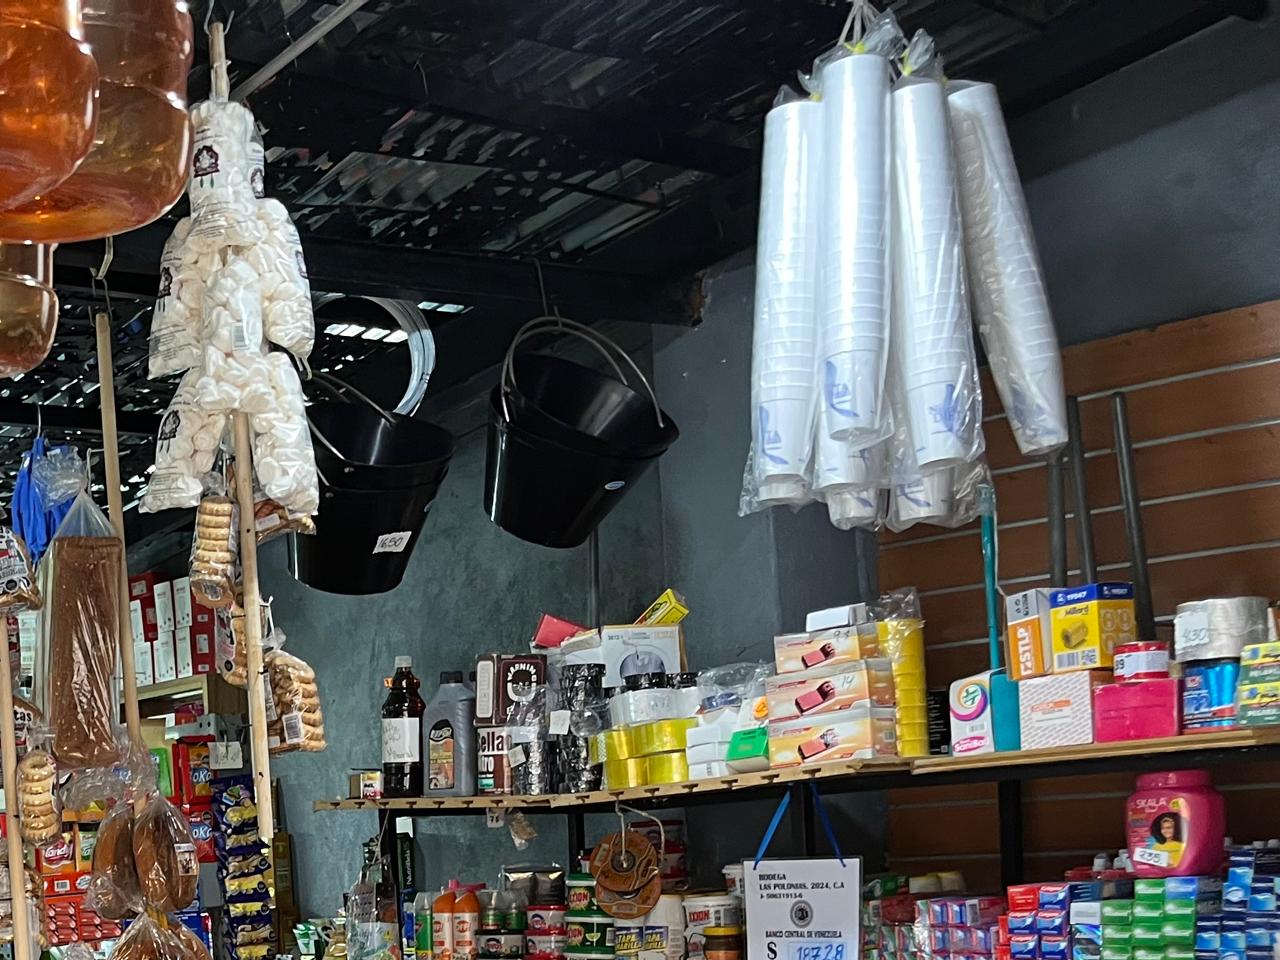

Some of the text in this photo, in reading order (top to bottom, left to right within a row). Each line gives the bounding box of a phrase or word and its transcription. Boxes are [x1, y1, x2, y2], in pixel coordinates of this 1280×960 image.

[759, 873, 786, 881] BODEGA
[759, 883, 772, 891] LAS
[766, 930, 784, 938] BANCO
[784, 930, 806, 938] CENTRAL
[814, 930, 843, 938] VENEZUELA
